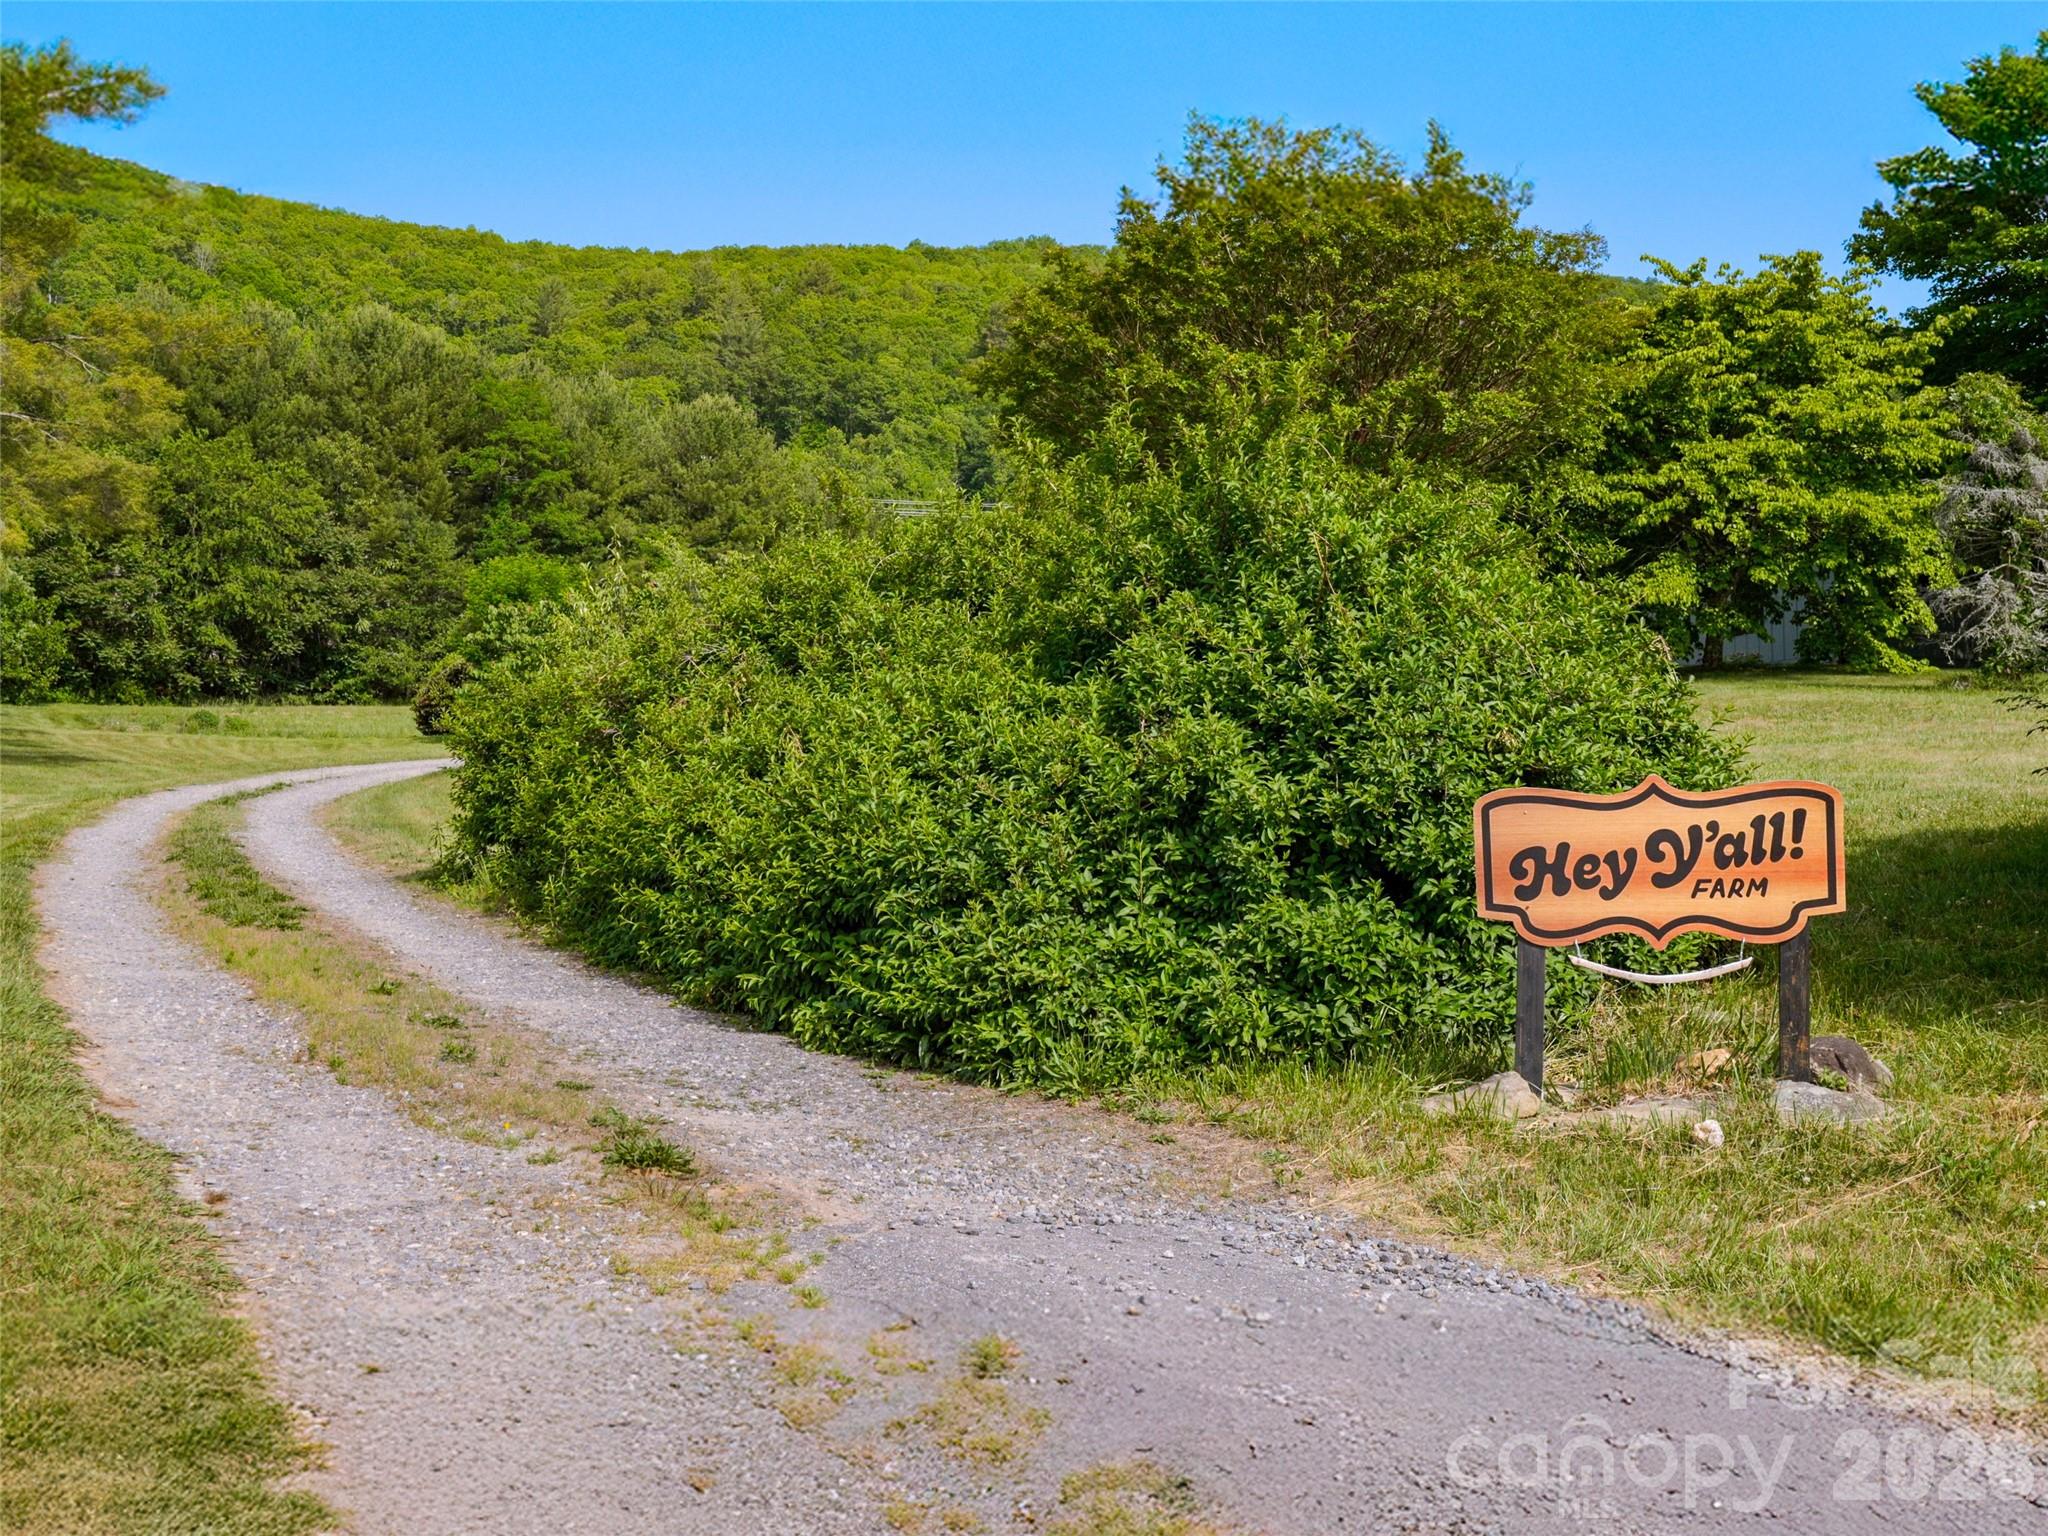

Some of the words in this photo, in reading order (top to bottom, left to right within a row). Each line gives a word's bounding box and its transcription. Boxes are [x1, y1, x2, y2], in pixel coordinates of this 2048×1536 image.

[1509, 841, 1638, 901] Hey
[1645, 808, 1807, 889] Y'all!
[1691, 877, 1769, 900] FARM
